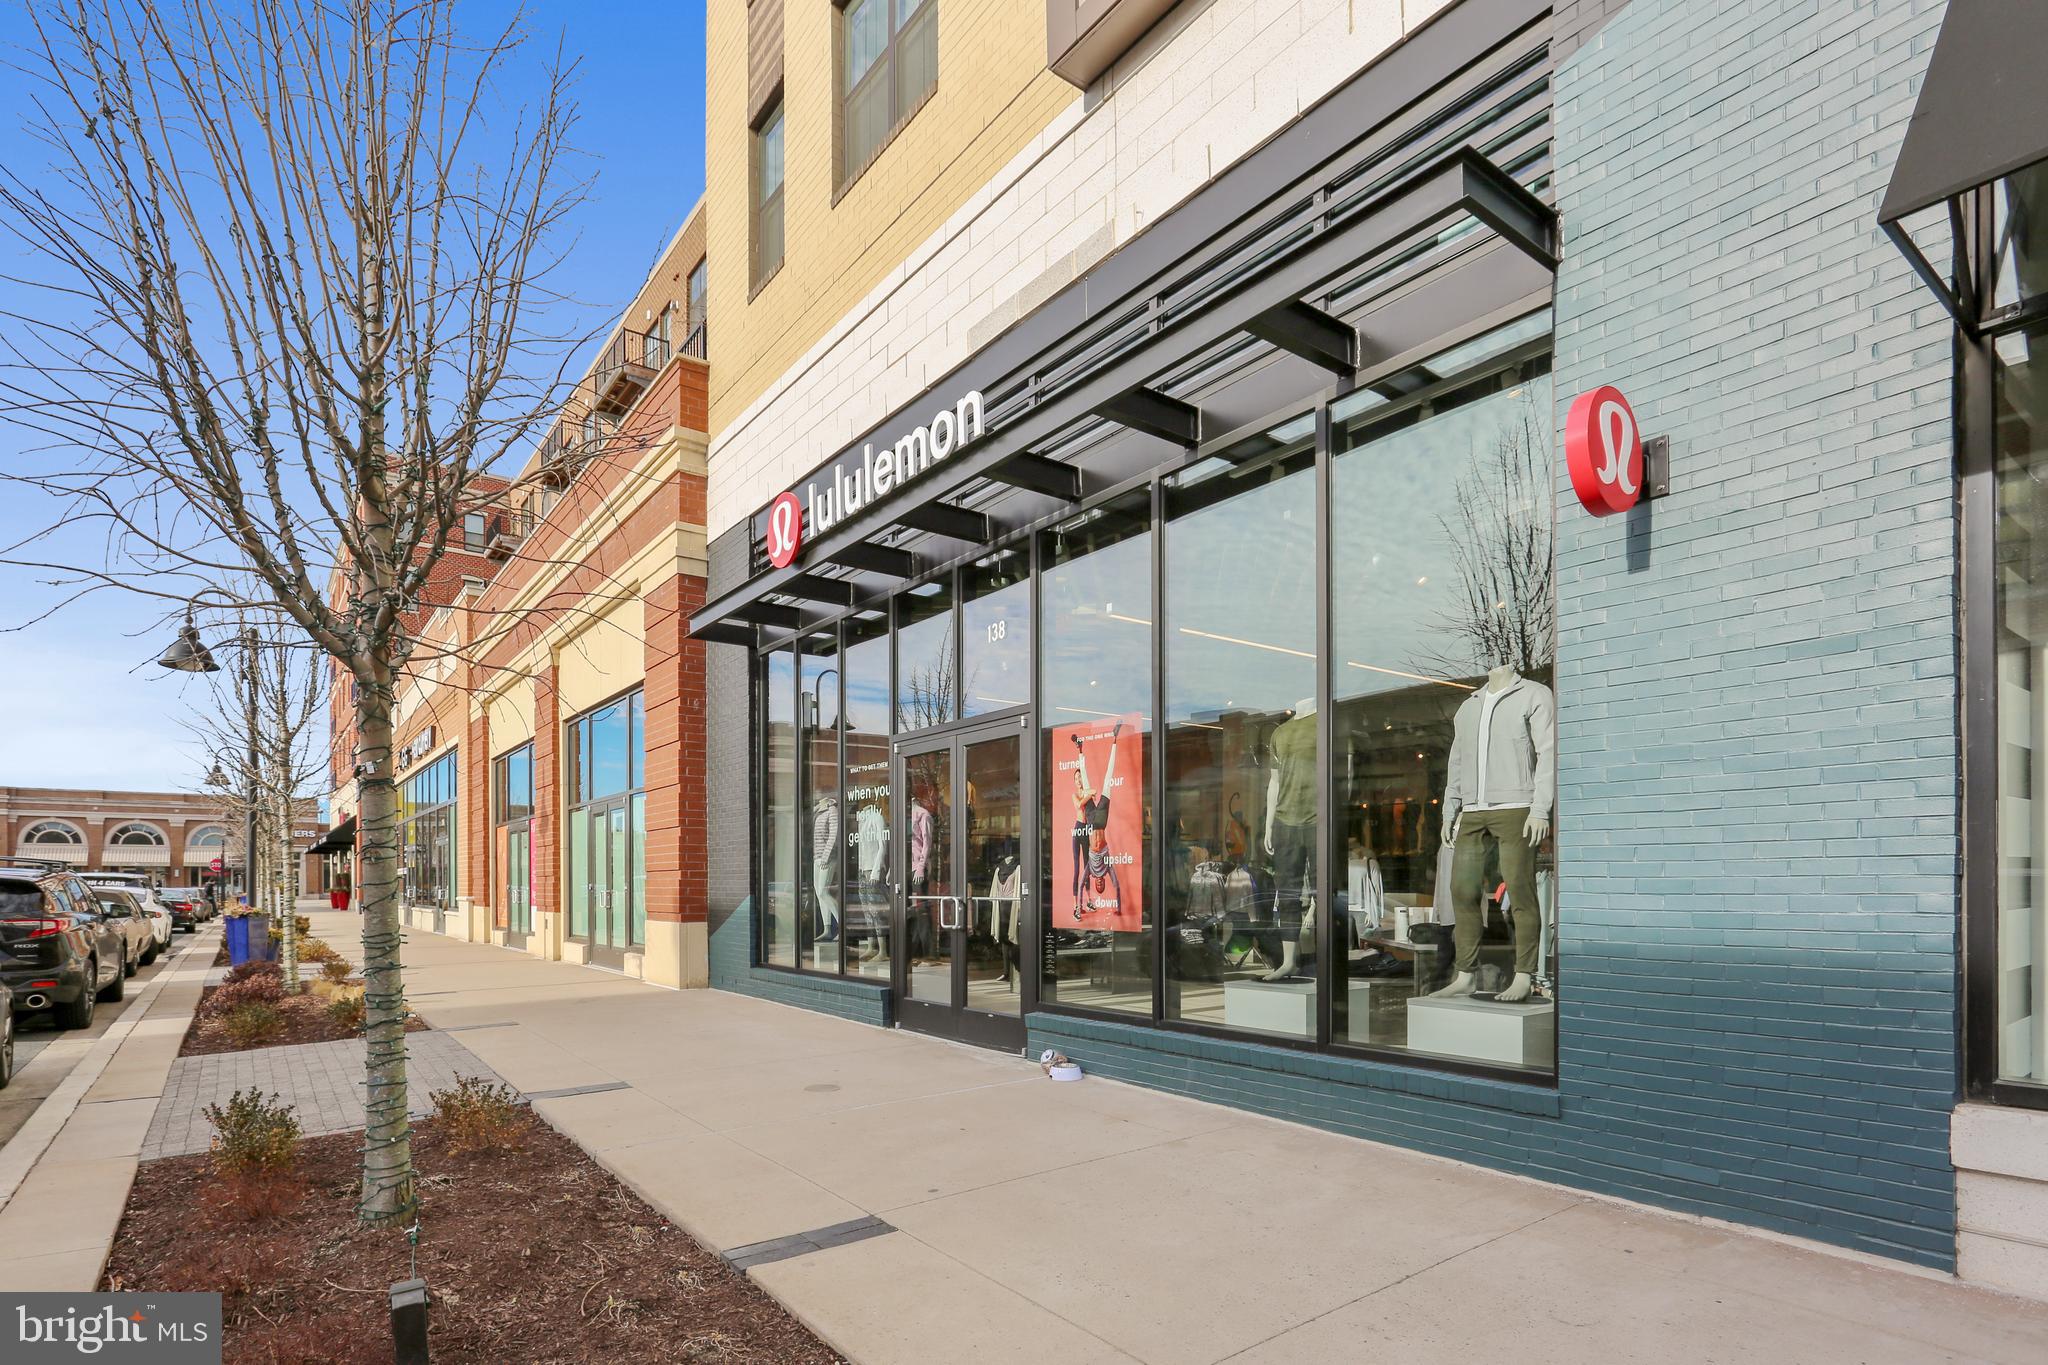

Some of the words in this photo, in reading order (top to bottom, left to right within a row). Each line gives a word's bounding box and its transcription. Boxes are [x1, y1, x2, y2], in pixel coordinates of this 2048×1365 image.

[808, 389, 985, 537] lululemon
[987, 620, 1006, 644] 138
[1108, 776, 1124, 788] our
[847, 785, 871, 801] when
[874, 785, 890, 801] you
[1071, 824, 1094, 837] world
[1103, 852, 1133, 867] upside
[1095, 896, 1118, 908] down
